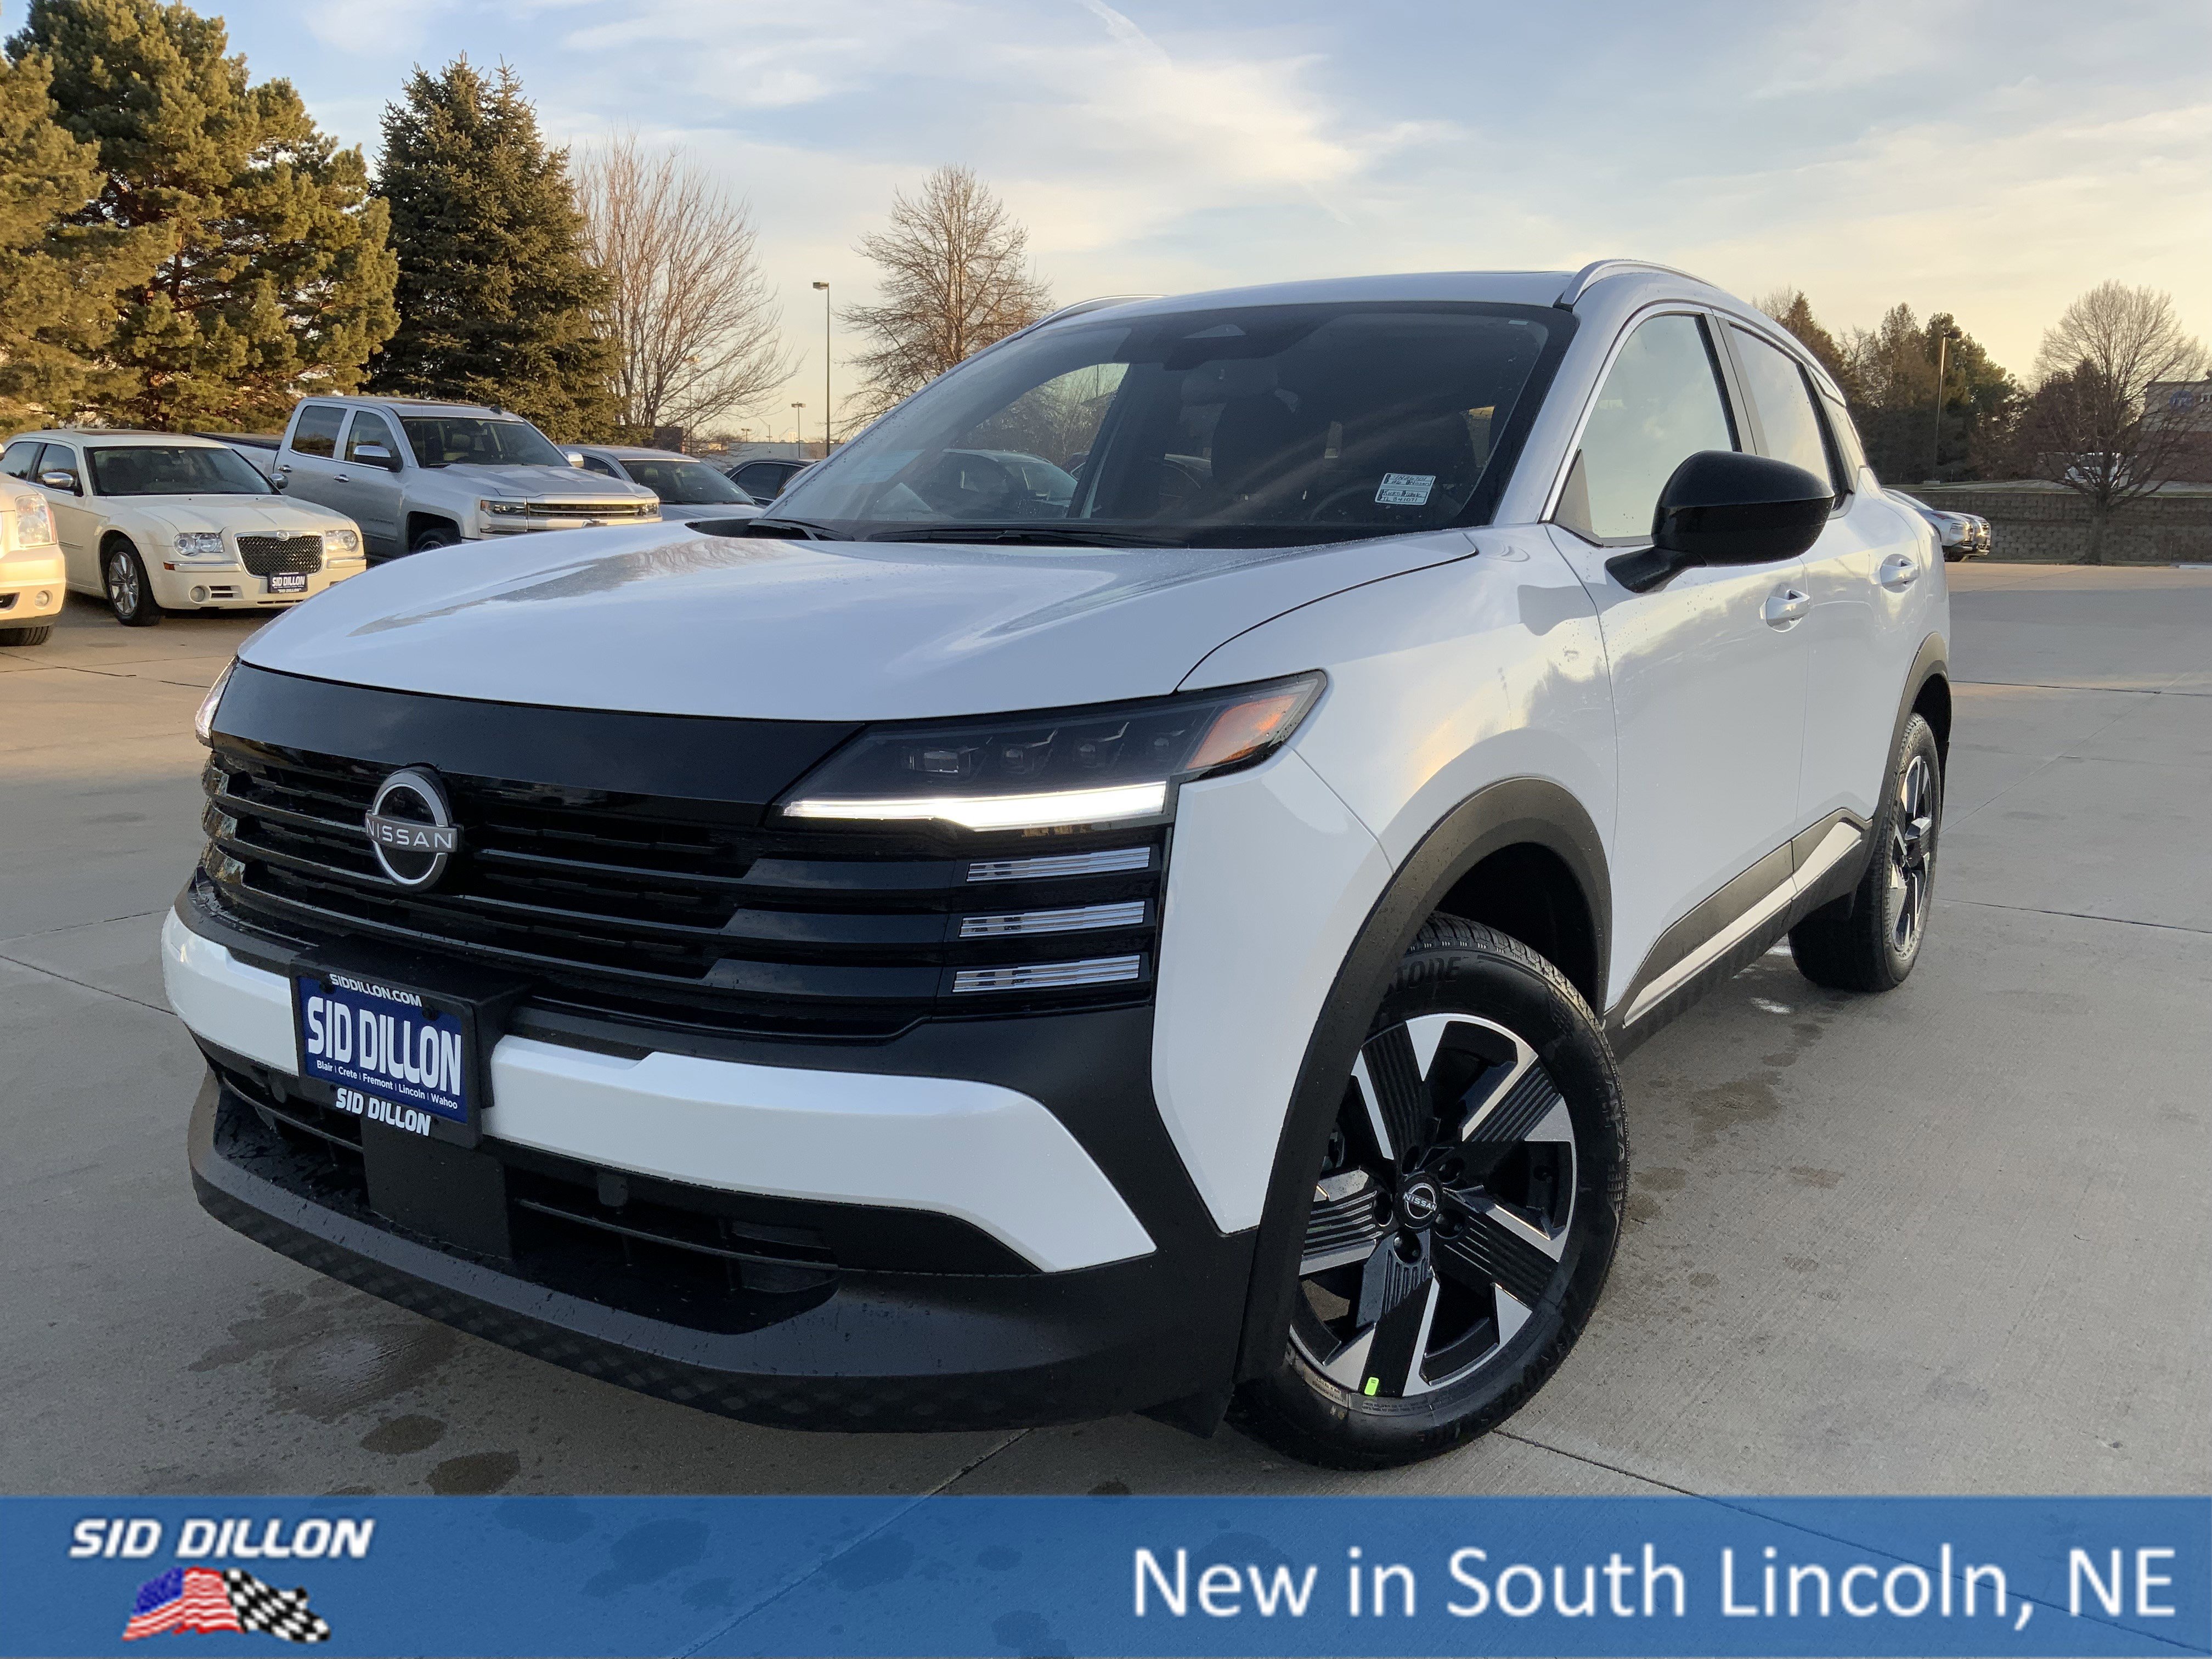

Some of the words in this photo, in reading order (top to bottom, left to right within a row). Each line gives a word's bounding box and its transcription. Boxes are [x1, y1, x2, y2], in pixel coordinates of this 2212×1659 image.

[272, 577, 283, 586] SID
[283, 576, 306, 586] DILLON
[366, 818, 452, 849] NISSAN
[329, 973, 422, 1007] SIDDILLON.COM
[307, 996, 352, 1063] SID
[359, 1008, 461, 1096] DILLON
[317, 1060, 333, 1072] Blair
[338, 1066, 358, 1079] Crete
[363, 1073, 393, 1090] Fremont
[399, 1083, 425, 1099] Lincoln
[431, 1093, 458, 1109] Wahoo
[336, 1087, 364, 1114] SID
[368, 1097, 431, 1136] DILLON
[1403, 1193, 1437, 1211] NISSAN
